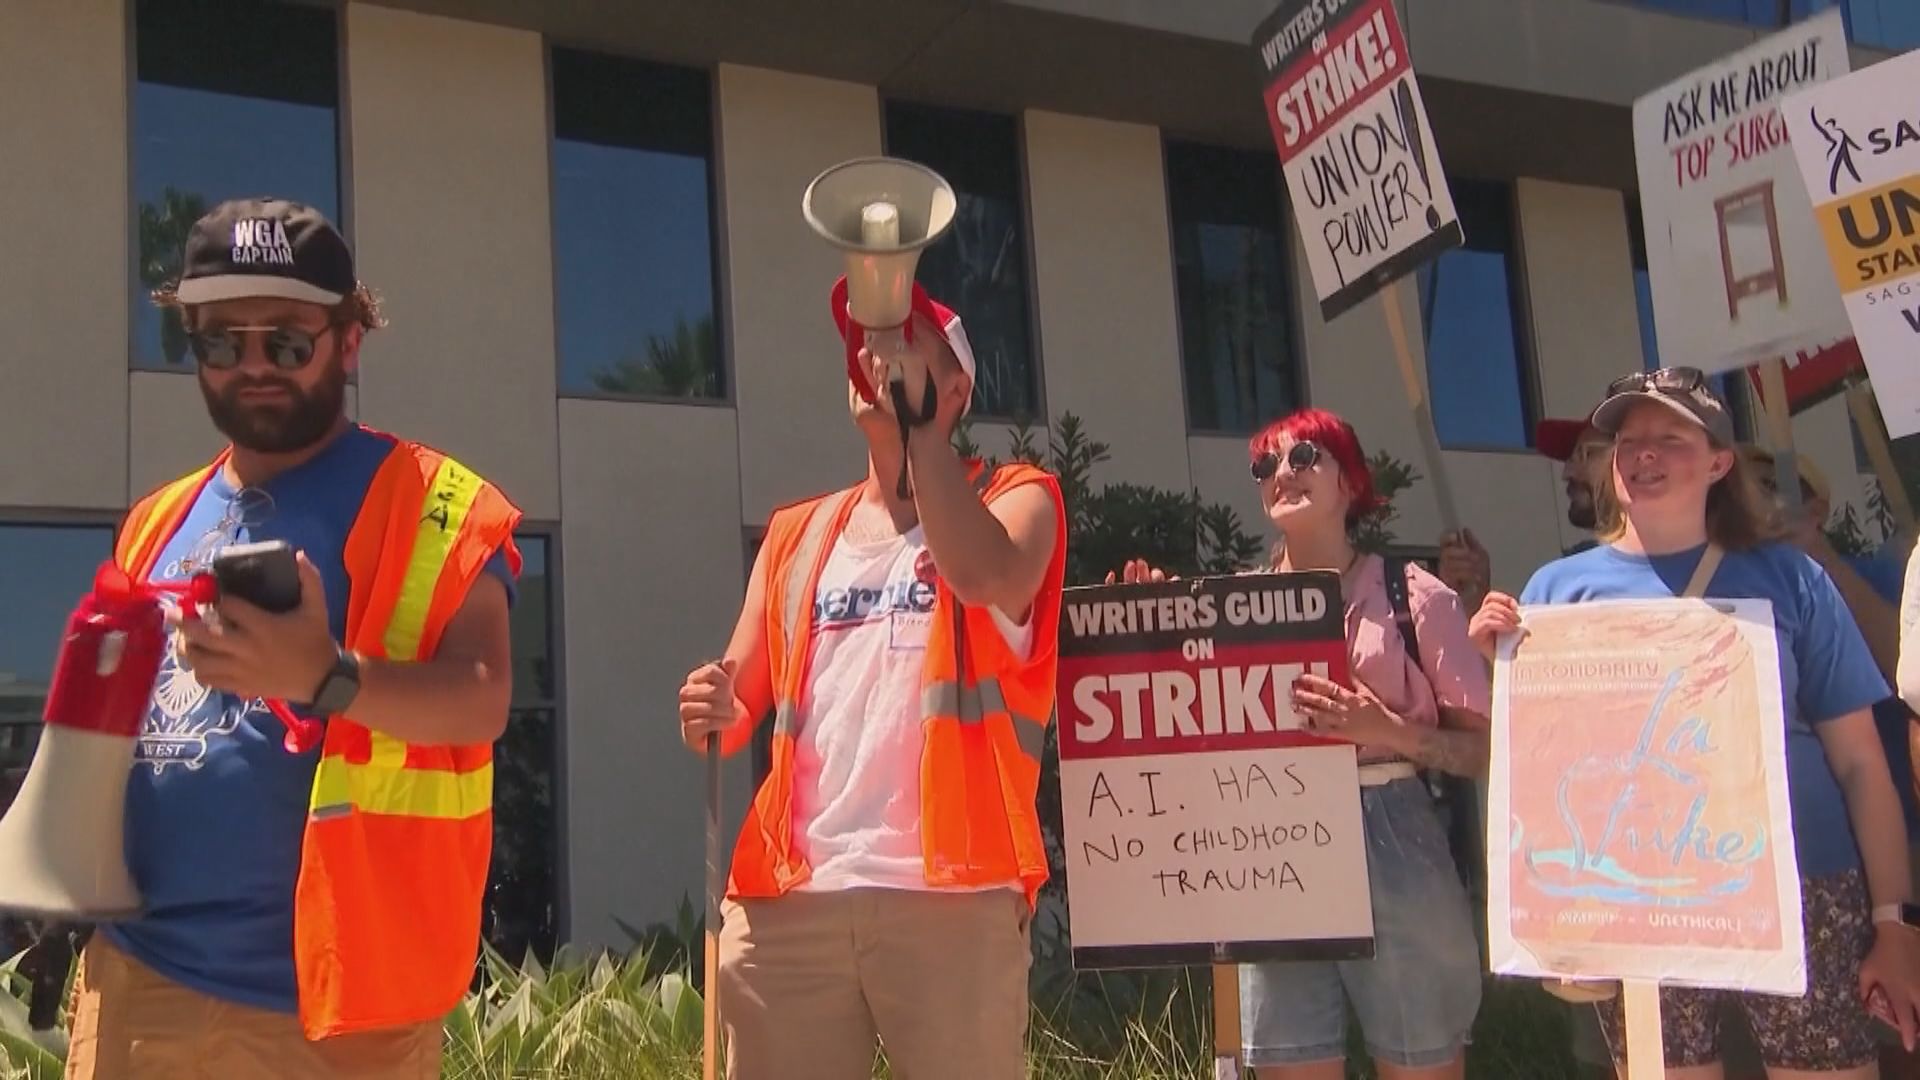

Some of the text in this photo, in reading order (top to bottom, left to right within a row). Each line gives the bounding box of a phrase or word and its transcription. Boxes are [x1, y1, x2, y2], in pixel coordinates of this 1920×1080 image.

[1261, 0, 1325, 71] WRITERS
[1312, 29, 1328, 56] ON
[1277, 8, 1397, 147] STRIKE!
[1664, 36, 1821, 144] ASK ME ABOUT
[1301, 86, 1408, 209] UNION
[1868, 119, 1920, 155] SA
[1670, 134, 1715, 190] TOP
[232, 246, 294, 264] CAPTAIN
[234, 219, 290, 248] WGA
[815, 580, 937, 620] erie
[1068, 588, 1327, 637] WRITERS GUILD
[1182, 638, 1215, 662] ON
[143, 743, 185, 757] WEST
[1088, 763, 1306, 818] A.I. HAS
[1083, 820, 1332, 867] NO CHILDHOOD
[1152, 861, 1305, 897] TRAUMA
